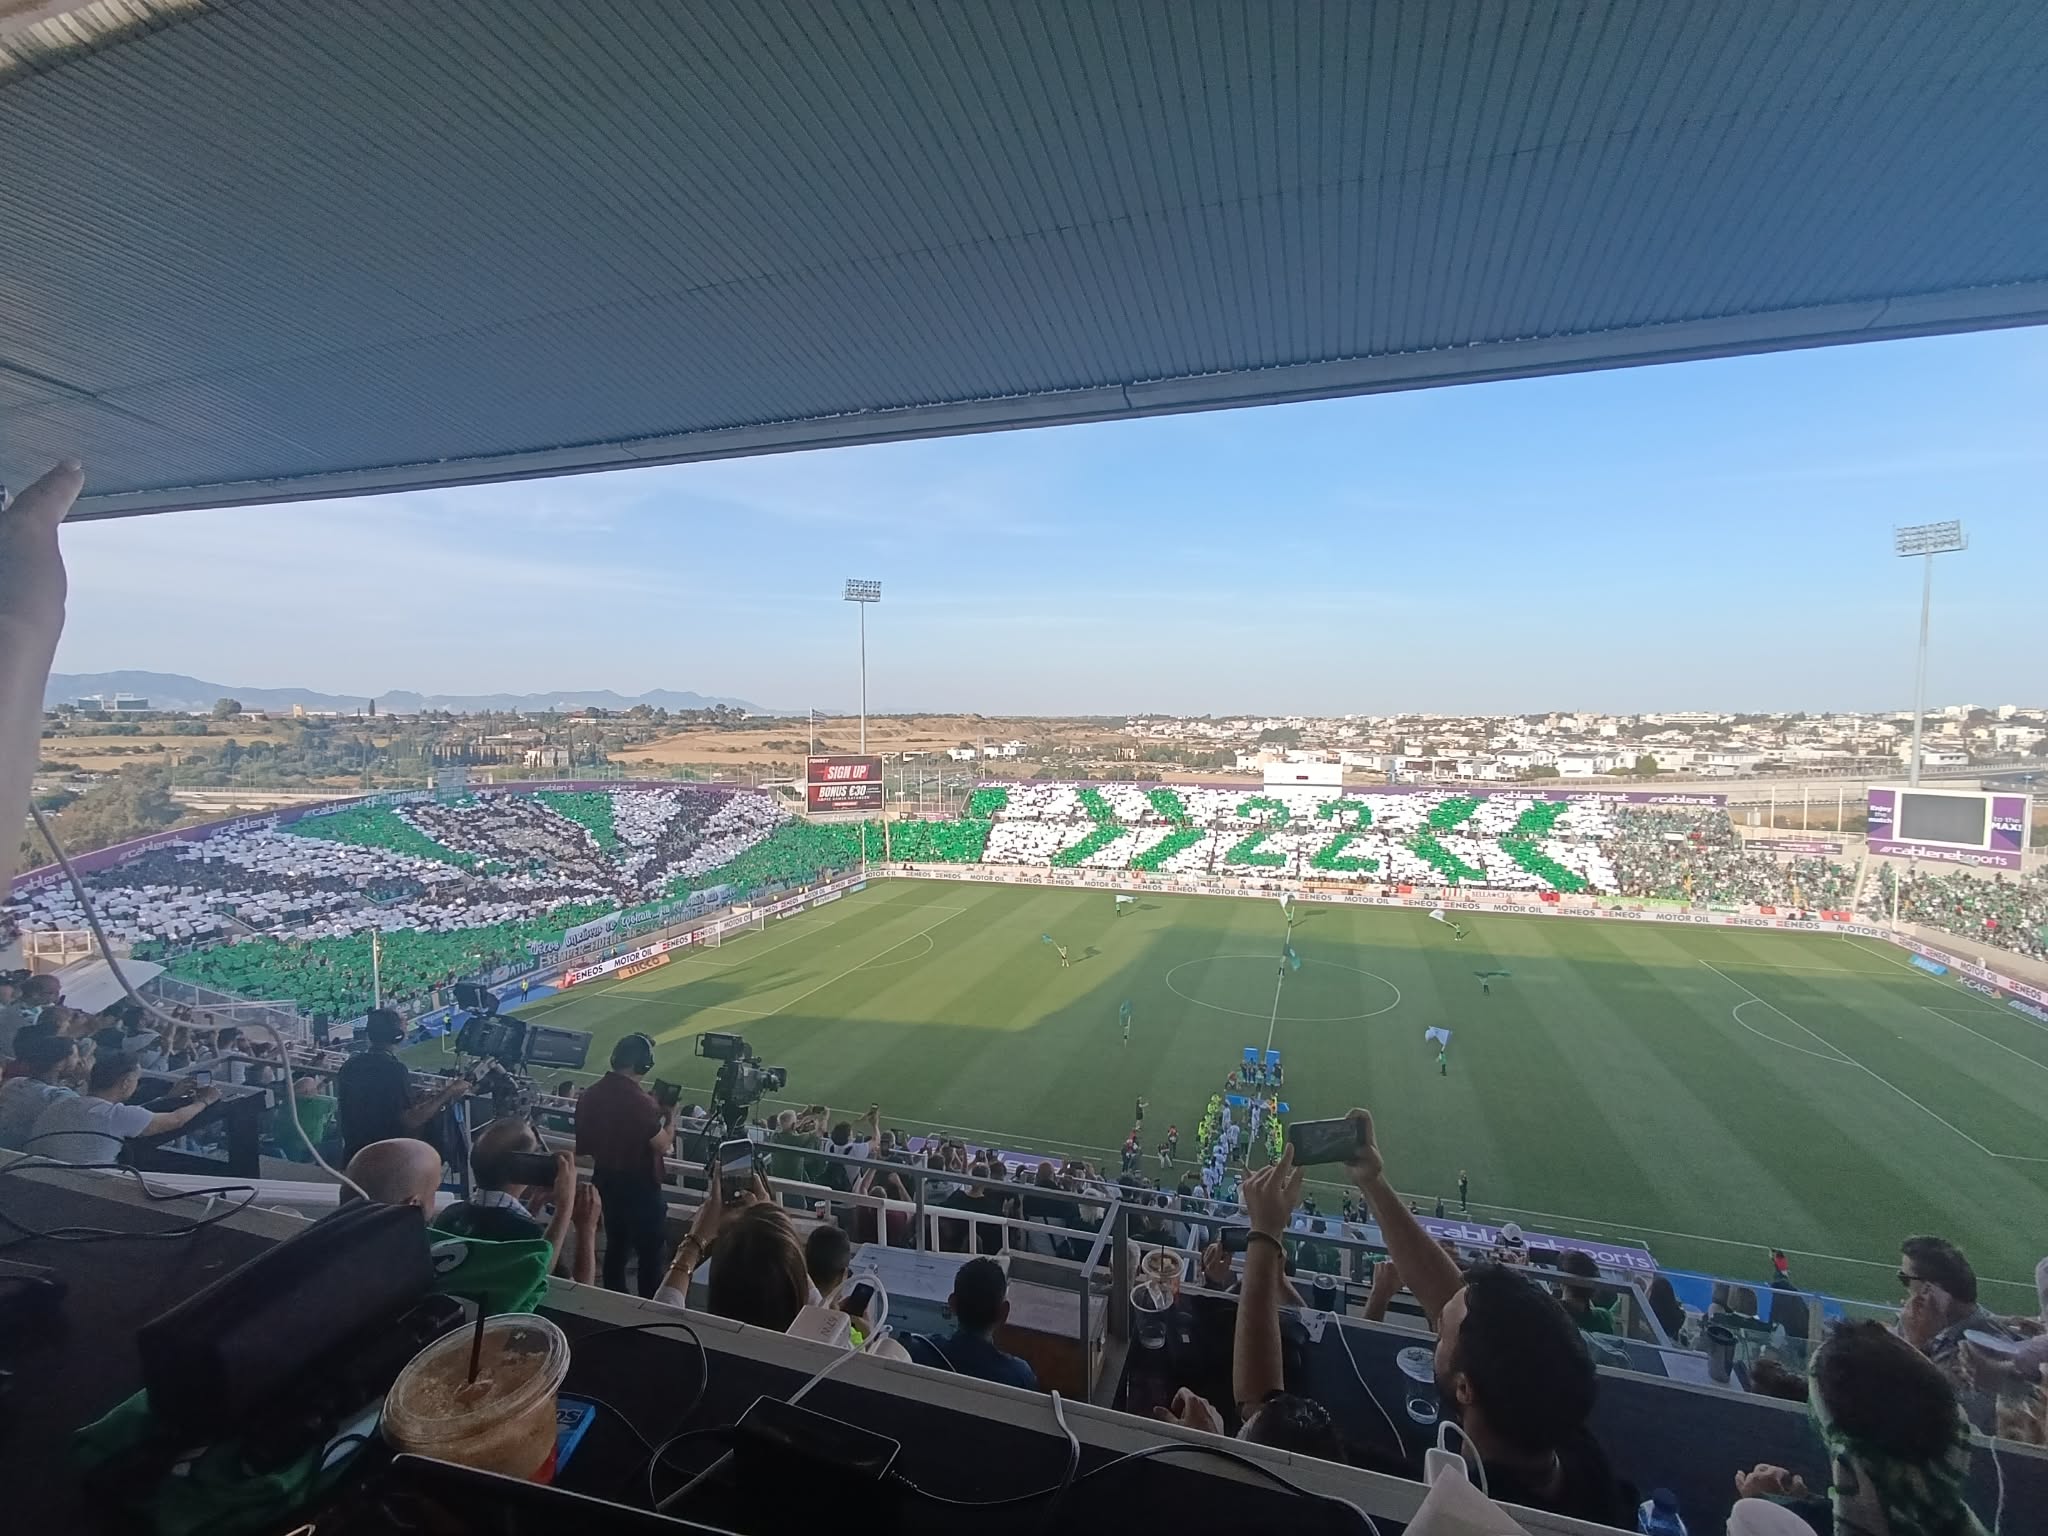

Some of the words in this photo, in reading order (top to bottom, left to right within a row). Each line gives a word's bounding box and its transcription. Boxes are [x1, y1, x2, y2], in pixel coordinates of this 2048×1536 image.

[827, 765, 851, 780] SIGN
[853, 765, 867, 778] UP
[819, 786, 847, 798] BONUS
[849, 785, 867, 796] €30
[1497, 790, 1548, 800] cablenet
[1574, 792, 1629, 802] cablenet
[1657, 794, 1717, 805] cablenet
[1208, 888, 1236, 896] MOTOR
[1304, 893, 1332, 902] ENEOS
[1344, 896, 1375, 904] MOTOR
[1408, 899, 1438, 908] ENEOS
[1450, 902, 1480, 910] ENEOS
[1493, 904, 1526, 912] MOTOR
[1528, 906, 1543, 914] OIL
[1563, 908, 1596, 917] ENEOS
[1609, 911, 1642, 919] ENEOS
[1656, 913, 1692, 922] MOTOR
[1694, 915, 1710, 923] OIL
[724, 918, 743, 928] MOTOR
[1733, 917, 1769, 926] ENEOS
[1784, 920, 1820, 930] ENEOS
[667, 936, 689, 948] ENEOS
[1930, 948, 1952, 964] ENEOS
[576, 964, 603, 981] ENEOS
[614, 952, 641, 968] MOTOR
[642, 948, 652, 958] OIL
[1960, 962, 1986, 978] MOTOR
[1987, 971, 1998, 984] OIL
[1957, 975, 1994, 997] X-CARS
[2014, 982, 2042, 1000] ENEOS
